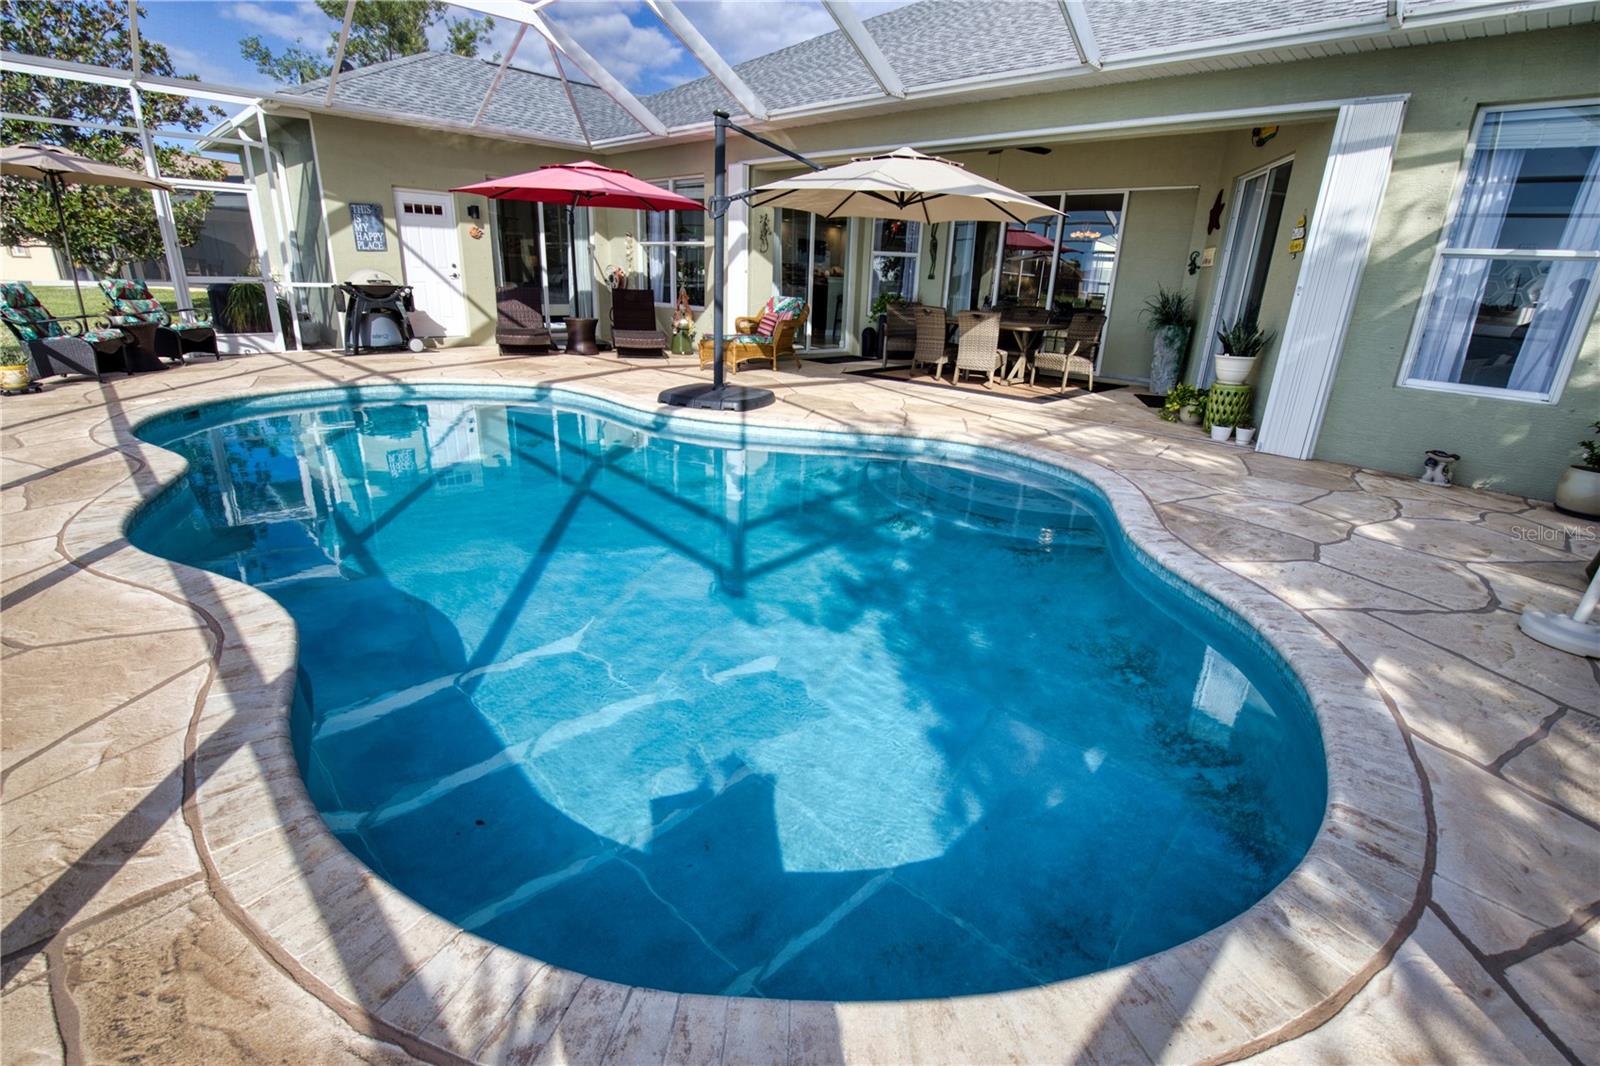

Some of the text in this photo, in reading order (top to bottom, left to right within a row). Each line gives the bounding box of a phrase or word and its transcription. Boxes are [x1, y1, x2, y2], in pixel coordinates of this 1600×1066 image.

[351, 204, 372, 214] THIS
[353, 214, 361, 223] IS
[354, 223, 369, 232] MY
[356, 232, 384, 241] HAPPY
[357, 241, 384, 250] PLACE
